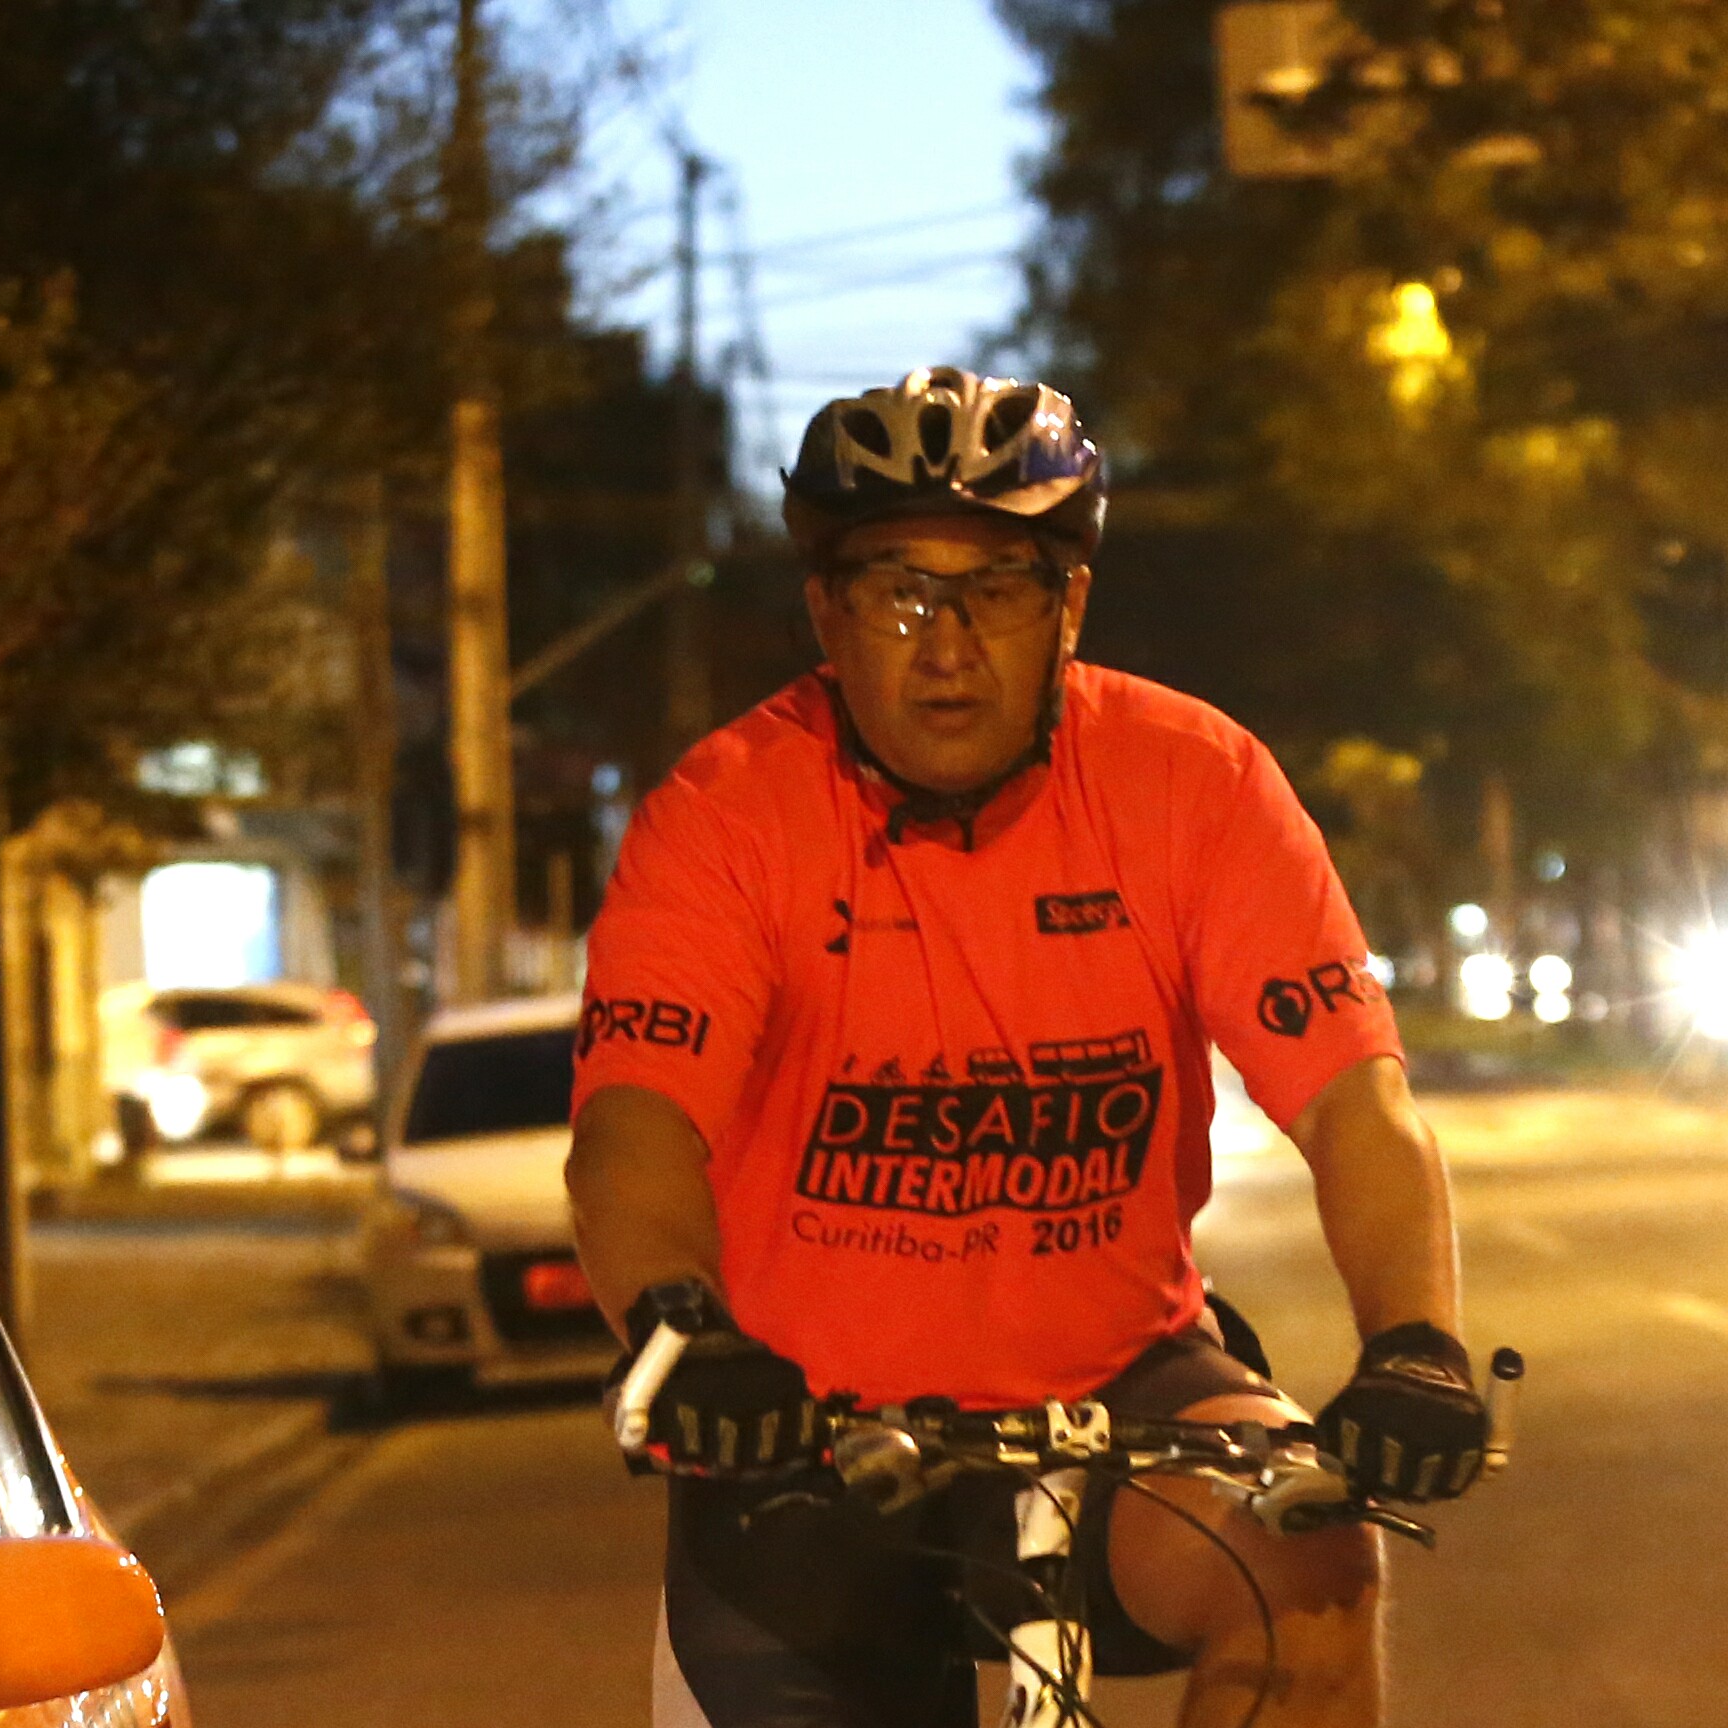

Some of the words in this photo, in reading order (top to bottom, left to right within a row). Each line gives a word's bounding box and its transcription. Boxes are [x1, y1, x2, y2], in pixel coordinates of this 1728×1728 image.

[819, 1082, 1151, 1154] DESAFIO
[805, 1141, 1130, 1213] INTERMODAL
[1030, 1204, 1124, 1256] 2016
